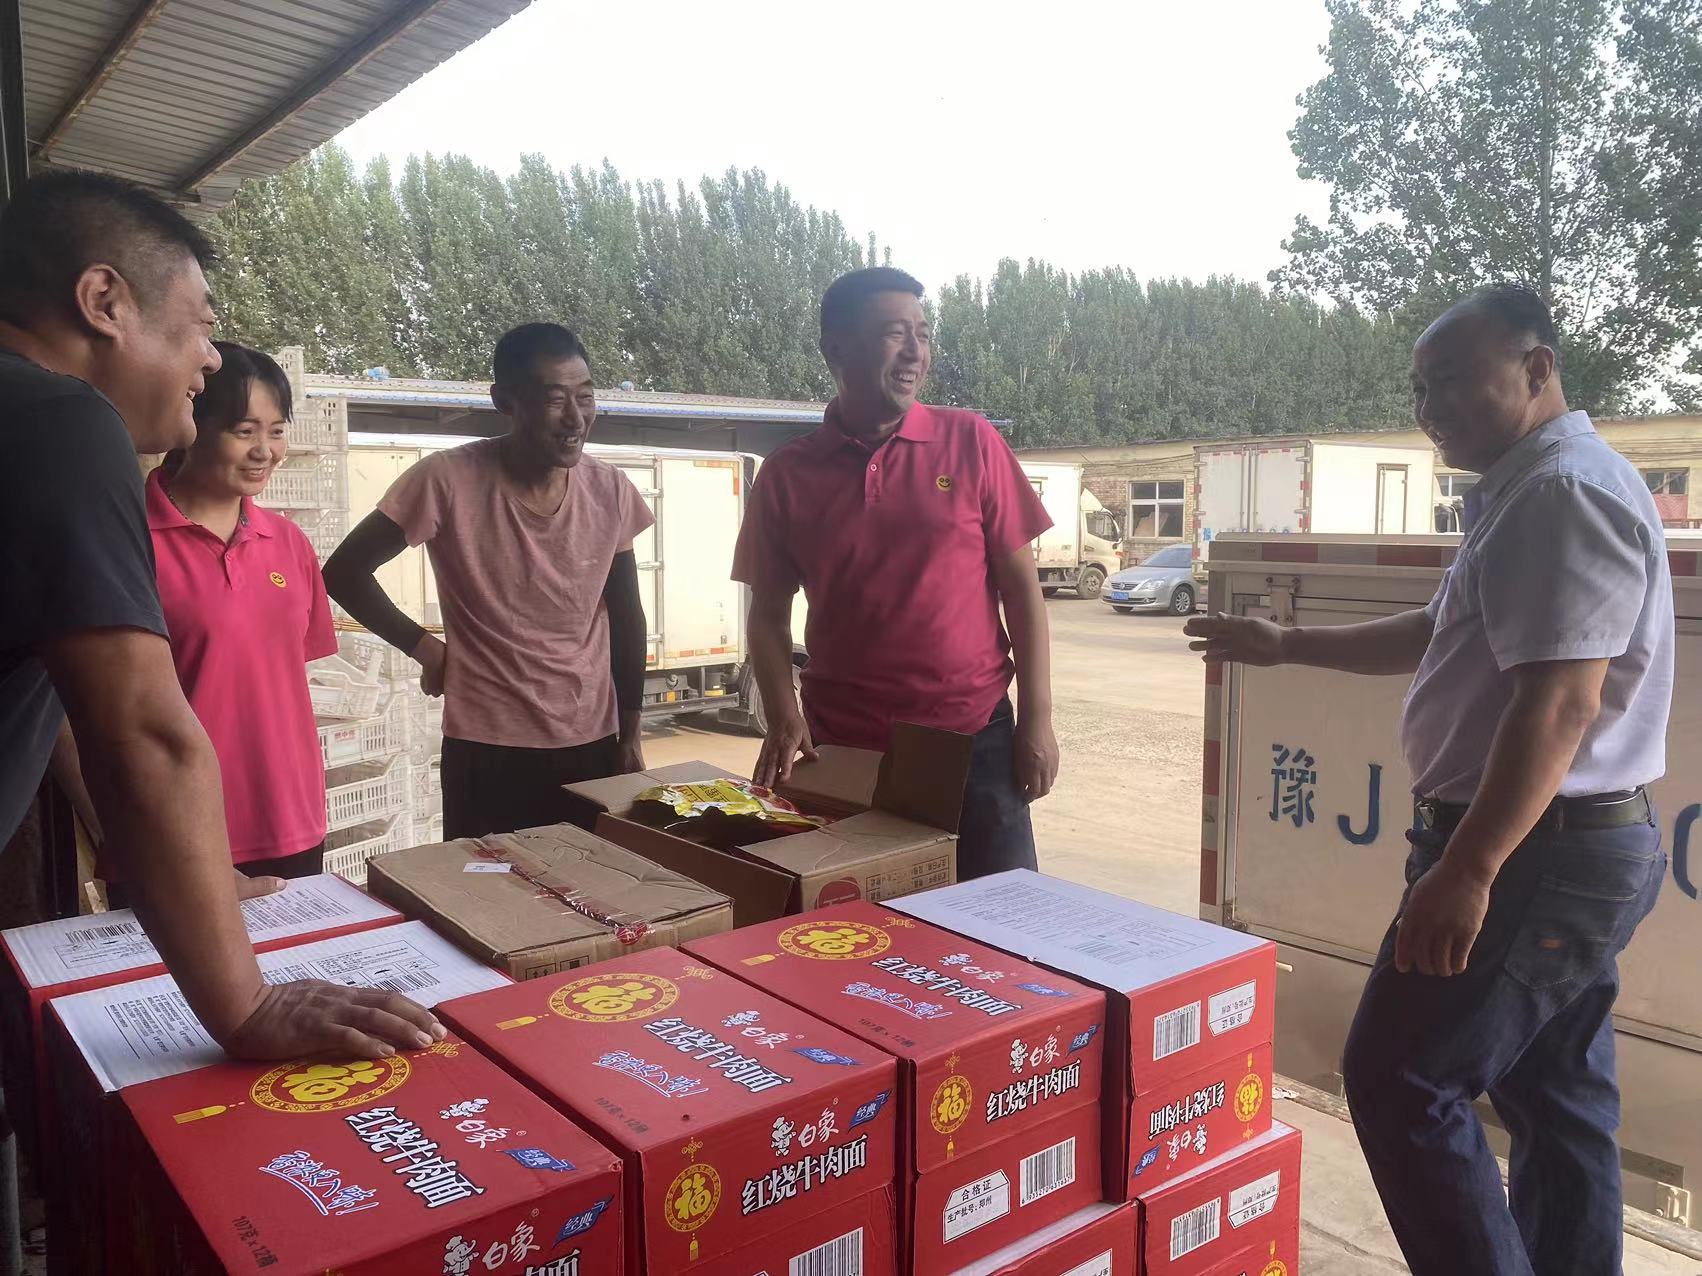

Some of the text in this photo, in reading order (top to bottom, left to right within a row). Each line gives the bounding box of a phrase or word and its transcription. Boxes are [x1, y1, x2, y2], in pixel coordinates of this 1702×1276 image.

[871, 957, 1023, 1016] 红烧牛肉面
[960, 965, 1005, 983] 白象
[642, 1016, 792, 1093] 红烧牛肉面
[740, 1026, 789, 1049] 白象
[1029, 1033, 1060, 1067] 白象
[855, 1103, 877, 1119] 经典
[938, 1083, 965, 1123] 福
[985, 1059, 1081, 1123] 红烧牛肉面
[1148, 1080, 1226, 1140] 红烧牛肉面
[1239, 1083, 1258, 1115] 福
[455, 1119, 511, 1149] 白象
[797, 1107, 840, 1148] 白象
[1167, 1130, 1192, 1162] 白象
[344, 1105, 487, 1209] 红烧牛肉面
[741, 1134, 868, 1216] 红烧牛肉面
[675, 1173, 712, 1221] 福
[961, 1178, 992, 1201] 合格证
[565, 1212, 594, 1232] 经典
[482, 1220, 541, 1271] 白象
